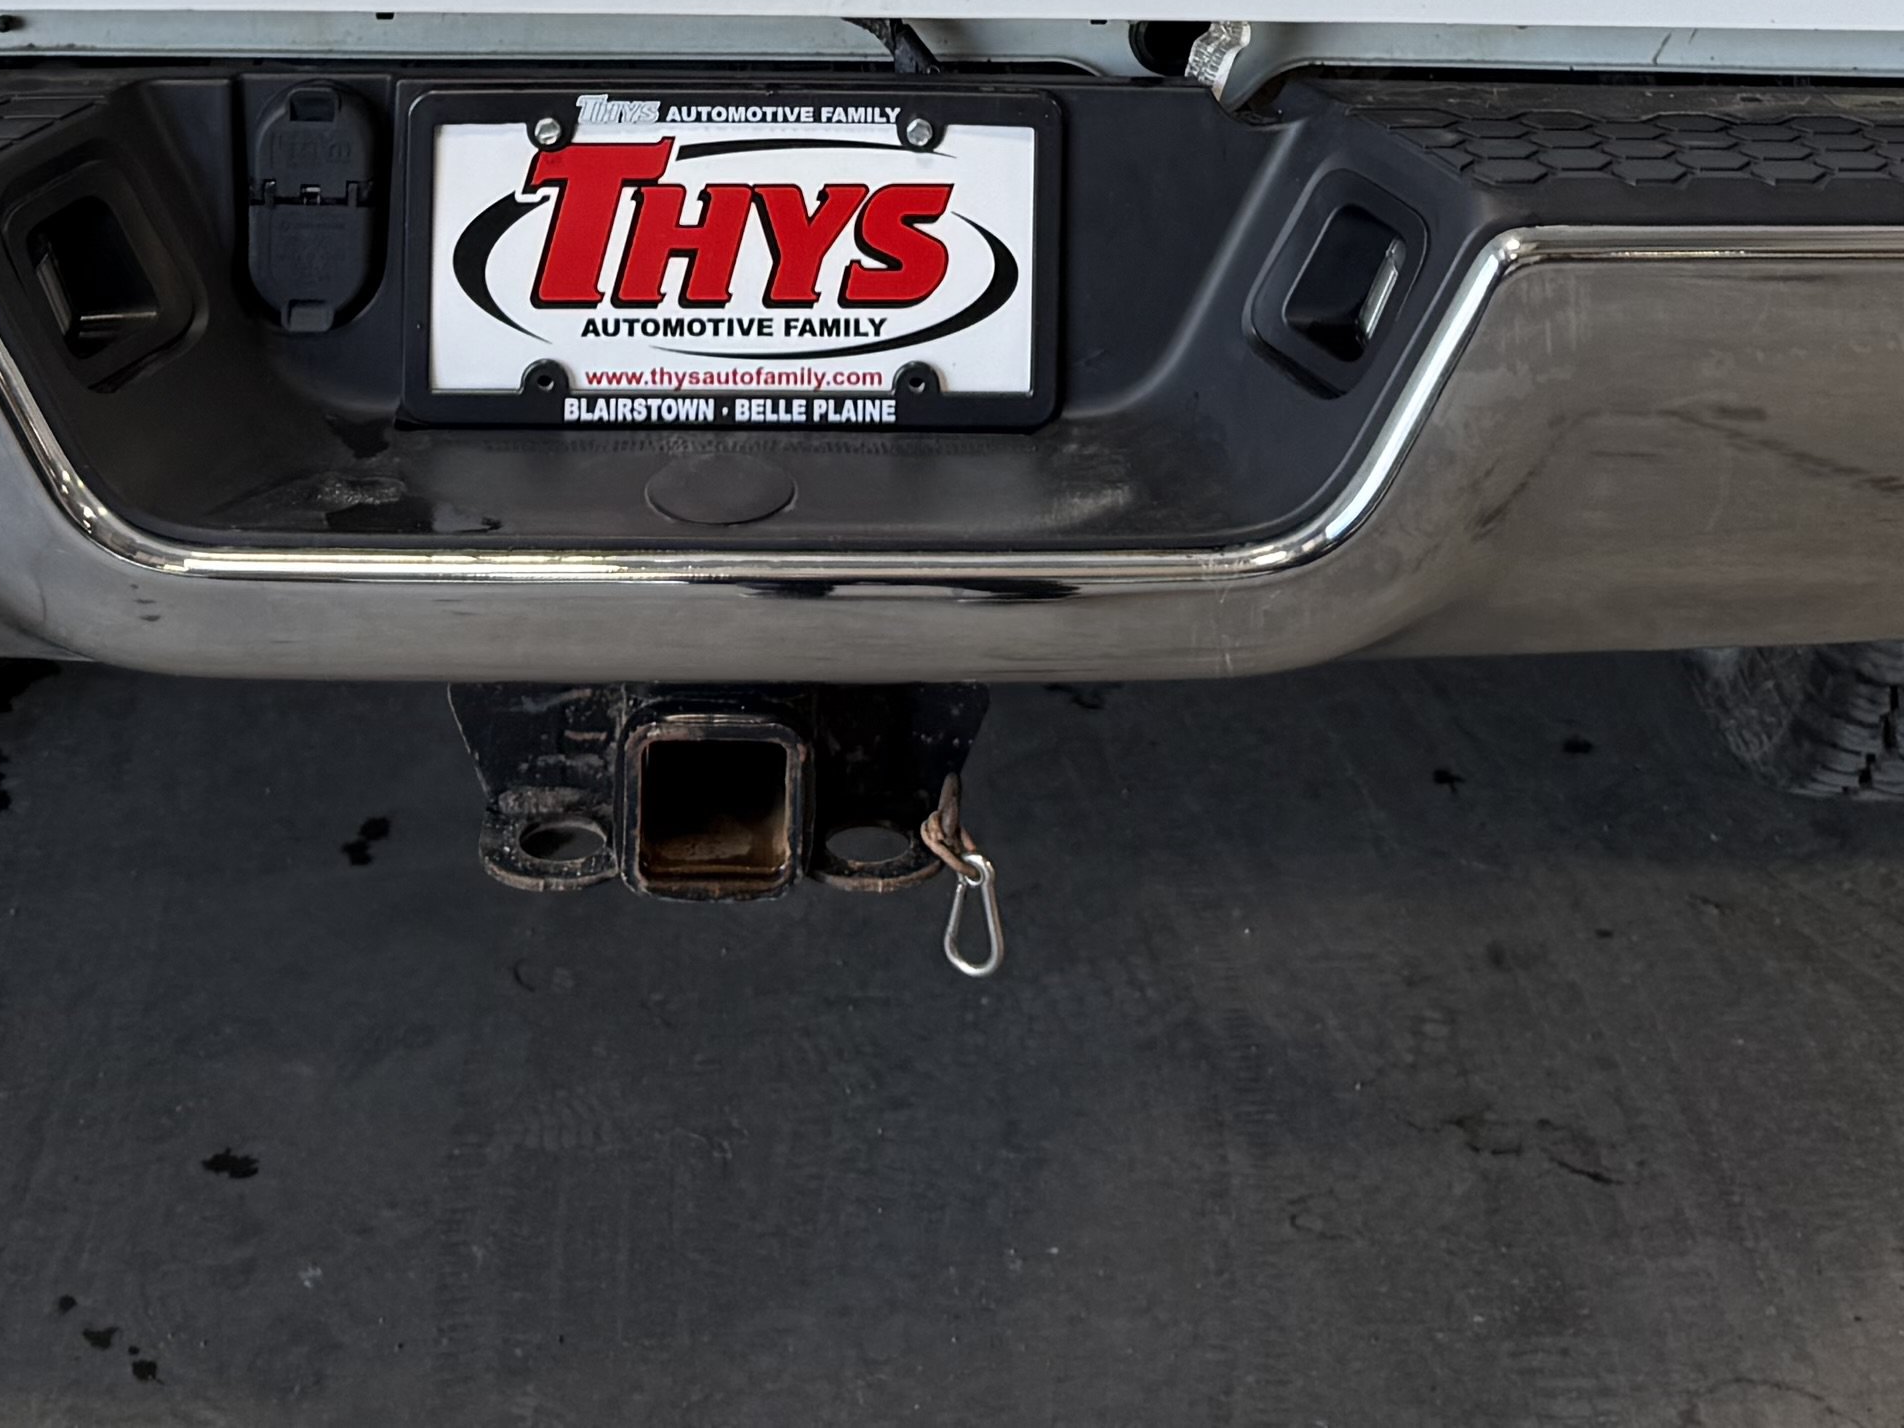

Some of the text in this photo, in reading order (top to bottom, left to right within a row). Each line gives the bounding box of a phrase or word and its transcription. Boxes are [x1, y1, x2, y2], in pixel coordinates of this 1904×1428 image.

[665, 106, 814, 123] AUTOMOTIVE
[821, 106, 901, 123] FAMILY
[522, 135, 955, 309] THYS
[581, 317, 888, 338] AUTOMOTIVE FAMILY
[585, 366, 883, 392] www.thysautofamily.com
[563, 397, 897, 424] BLAIRSTOWN BELLE PLAINE
